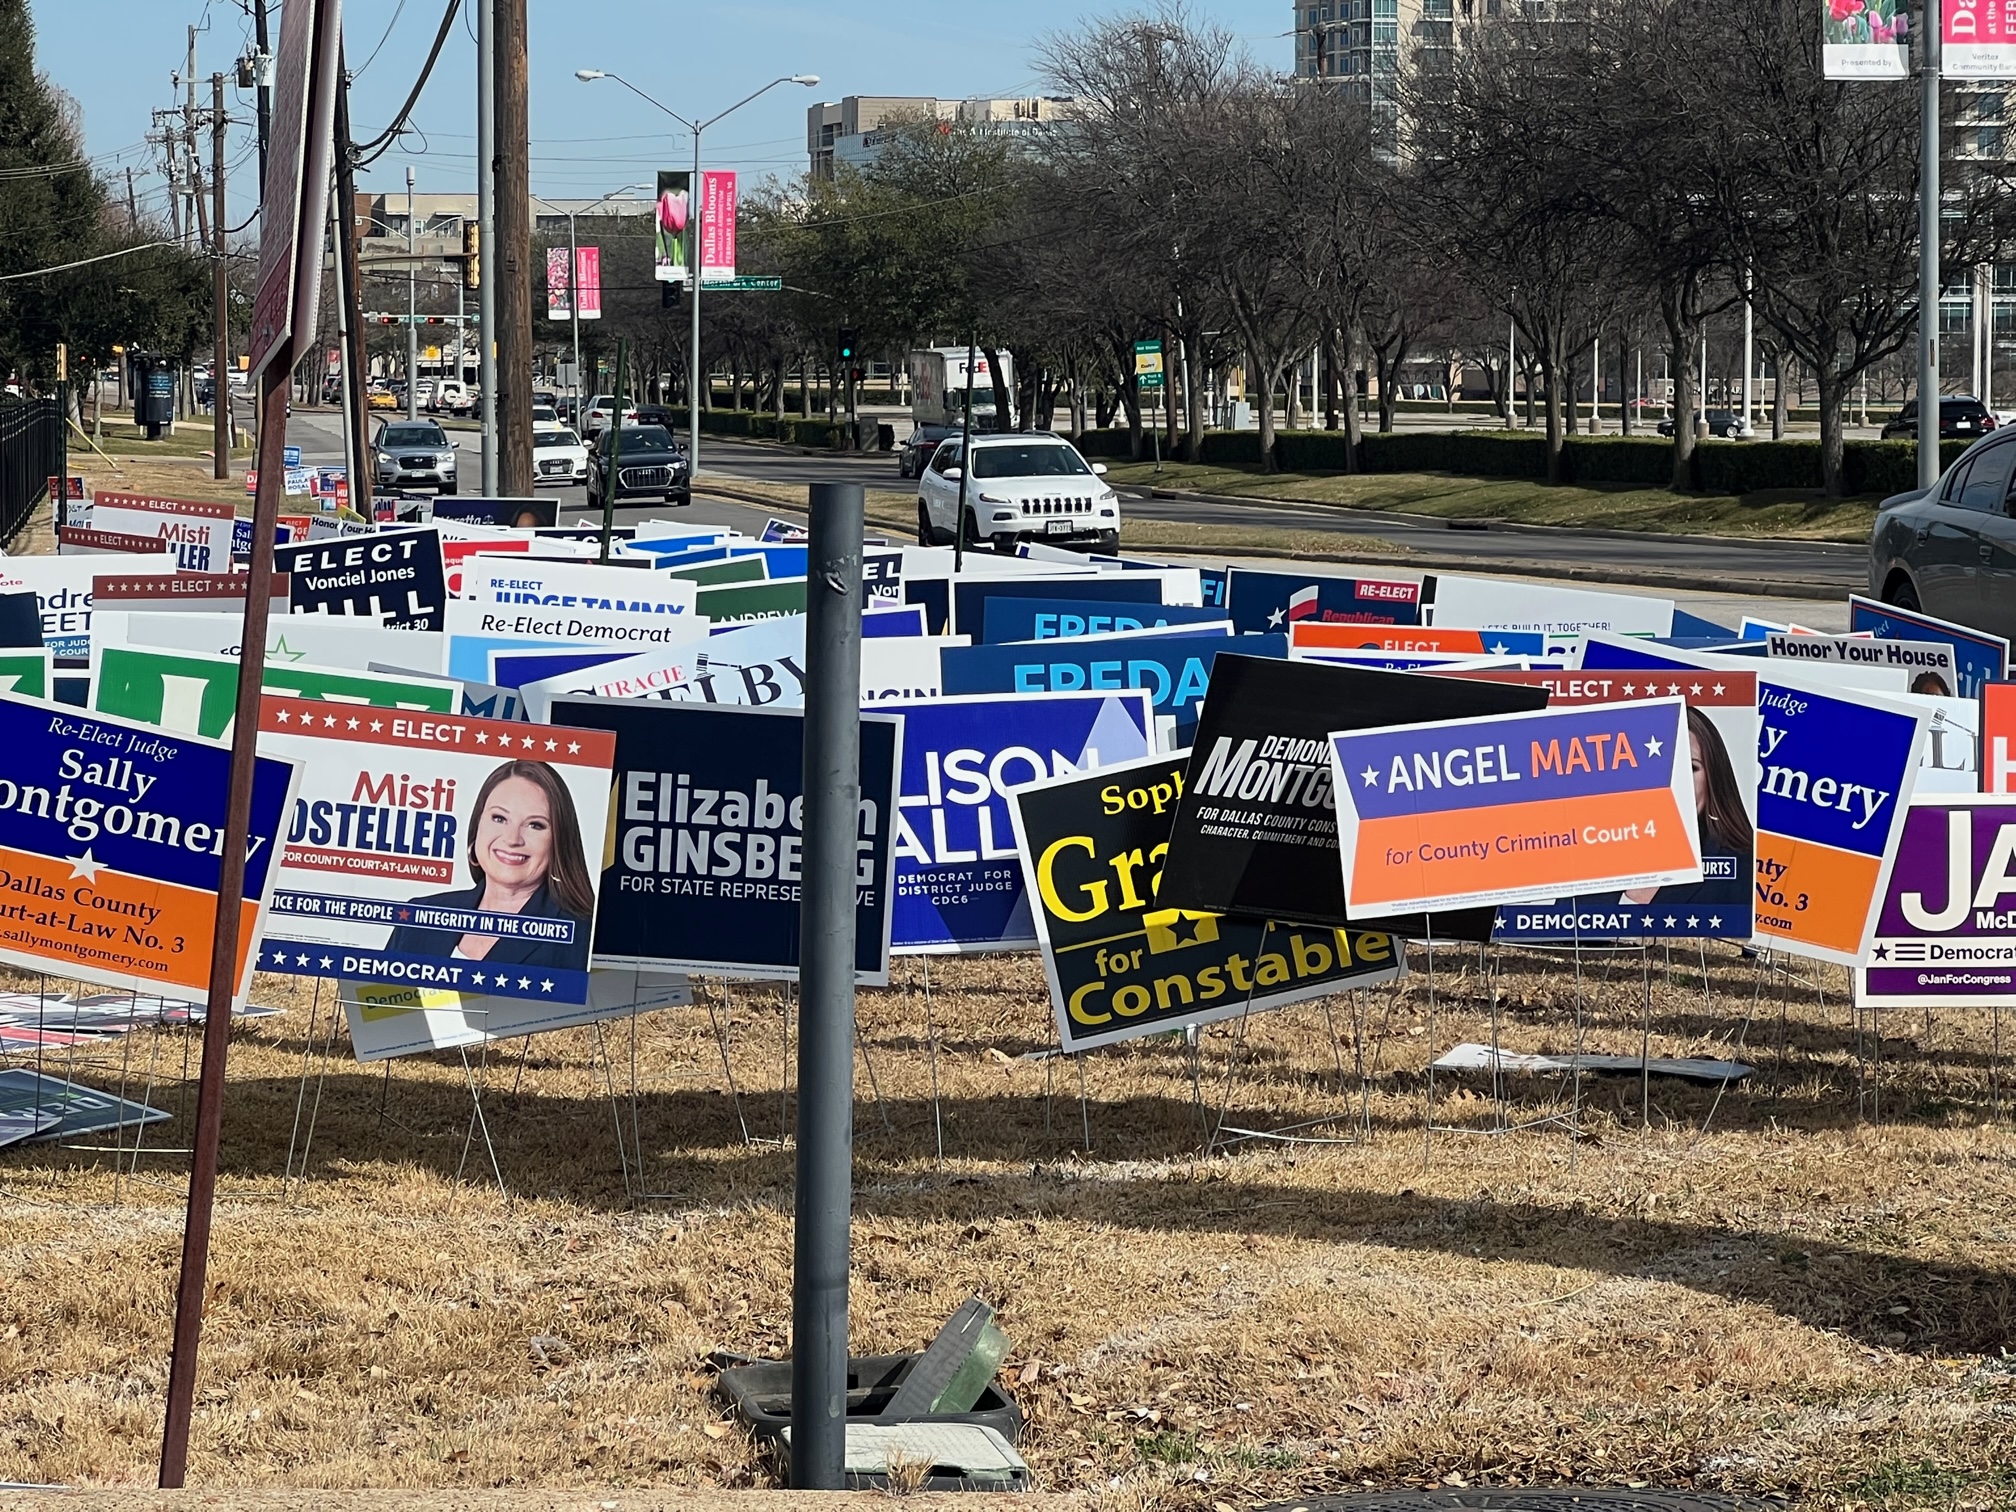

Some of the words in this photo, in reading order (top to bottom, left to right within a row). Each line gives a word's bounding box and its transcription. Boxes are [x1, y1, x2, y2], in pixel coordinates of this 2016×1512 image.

[1842, 59, 1881, 67] Presented
[1883, 59, 1892, 68] by
[705, 177, 717, 223] Blooms
[704, 226, 717, 264] Dallas
[149, 500, 178, 511] ELECT
[158, 522, 210, 545] Misti
[312, 516, 338, 530] Honor
[100, 534, 122, 546] ELECT
[294, 540, 418, 573] ELECT
[171, 580, 212, 593] ELECT
[305, 573, 366, 591] Vonciel
[369, 566, 415, 584] Jones
[490, 578, 543, 591] RE-ELECT
[1359, 584, 1414, 600] RE-ELECT
[413, 618, 429, 631] 30
[481, 614, 562, 636] Re-Elect
[567, 619, 671, 643] Democrat
[1322, 609, 1395, 624] Republican
[1872, 619, 1890, 638] lect
[45, 641, 65, 649] FOR
[1771, 637, 1832, 660] Honor
[1834, 641, 1884, 663] Your
[1887, 644, 1949, 668] House
[599, 664, 687, 698] TRACIE
[1014, 657, 1210, 707] FREDA
[1541, 679, 1612, 698] ELECT
[1759, 688, 1808, 717] Judge
[48, 717, 123, 748] Re-Elect
[124, 735, 178, 763] Judge
[391, 719, 467, 744] ELECT
[1386, 744, 1521, 794] ANGEL
[1530, 731, 1639, 779] MATA
[58, 749, 157, 804] Sally
[351, 770, 458, 812] Misti
[1196, 806, 1220, 821] FOR
[1220, 809, 1263, 826] DALLAS
[1264, 814, 1309, 831] COUNTY
[1307, 819, 1339, 834] CONS
[1200, 824, 1250, 840] CHARACTER,
[1251, 830, 1306, 846] COMMITMENT
[1307, 836, 1324, 848] AND
[1385, 846, 1413, 867] for
[1418, 839, 1490, 864] County
[1496, 828, 1578, 855] Criminal
[1582, 823, 1639, 846] Court
[1643, 820, 1657, 839] 4
[281, 851, 302, 863] FOR
[304, 853, 346, 867] COUNTY
[346, 856, 420, 874] COURT-AT-LAW
[421, 864, 439, 877] NO.
[440, 866, 448, 878] 3
[622, 826, 874, 886] GINSBEG
[620, 875, 655, 893] FOR
[661, 878, 714, 897] STATE
[898, 871, 974, 884] DEMOCRAT
[984, 870, 1012, 880] FOR
[898, 884, 962, 896] DISTRICT
[967, 881, 1013, 892] JUDGE
[73, 888, 162, 925] County
[931, 894, 969, 905] CDC6
[1795, 893, 1809, 912] 3
[296, 897, 323, 914] FOR
[325, 899, 348, 916] THE
[349, 903, 394, 921] PEOPLE
[414, 909, 477, 930] INTEGRITY
[480, 915, 494, 931] IN
[497, 917, 519, 935] THE
[521, 920, 569, 940] COURTS
[1516, 913, 1632, 930] DEMOCRAT
[123, 925, 164, 951] No.
[171, 936, 185, 953] 3
[342, 956, 463, 984] DEMOCRAT
[1095, 946, 1144, 978] for
[1068, 927, 1391, 1026] Constable
[1917, 973, 2012, 986] @JanForCongress
